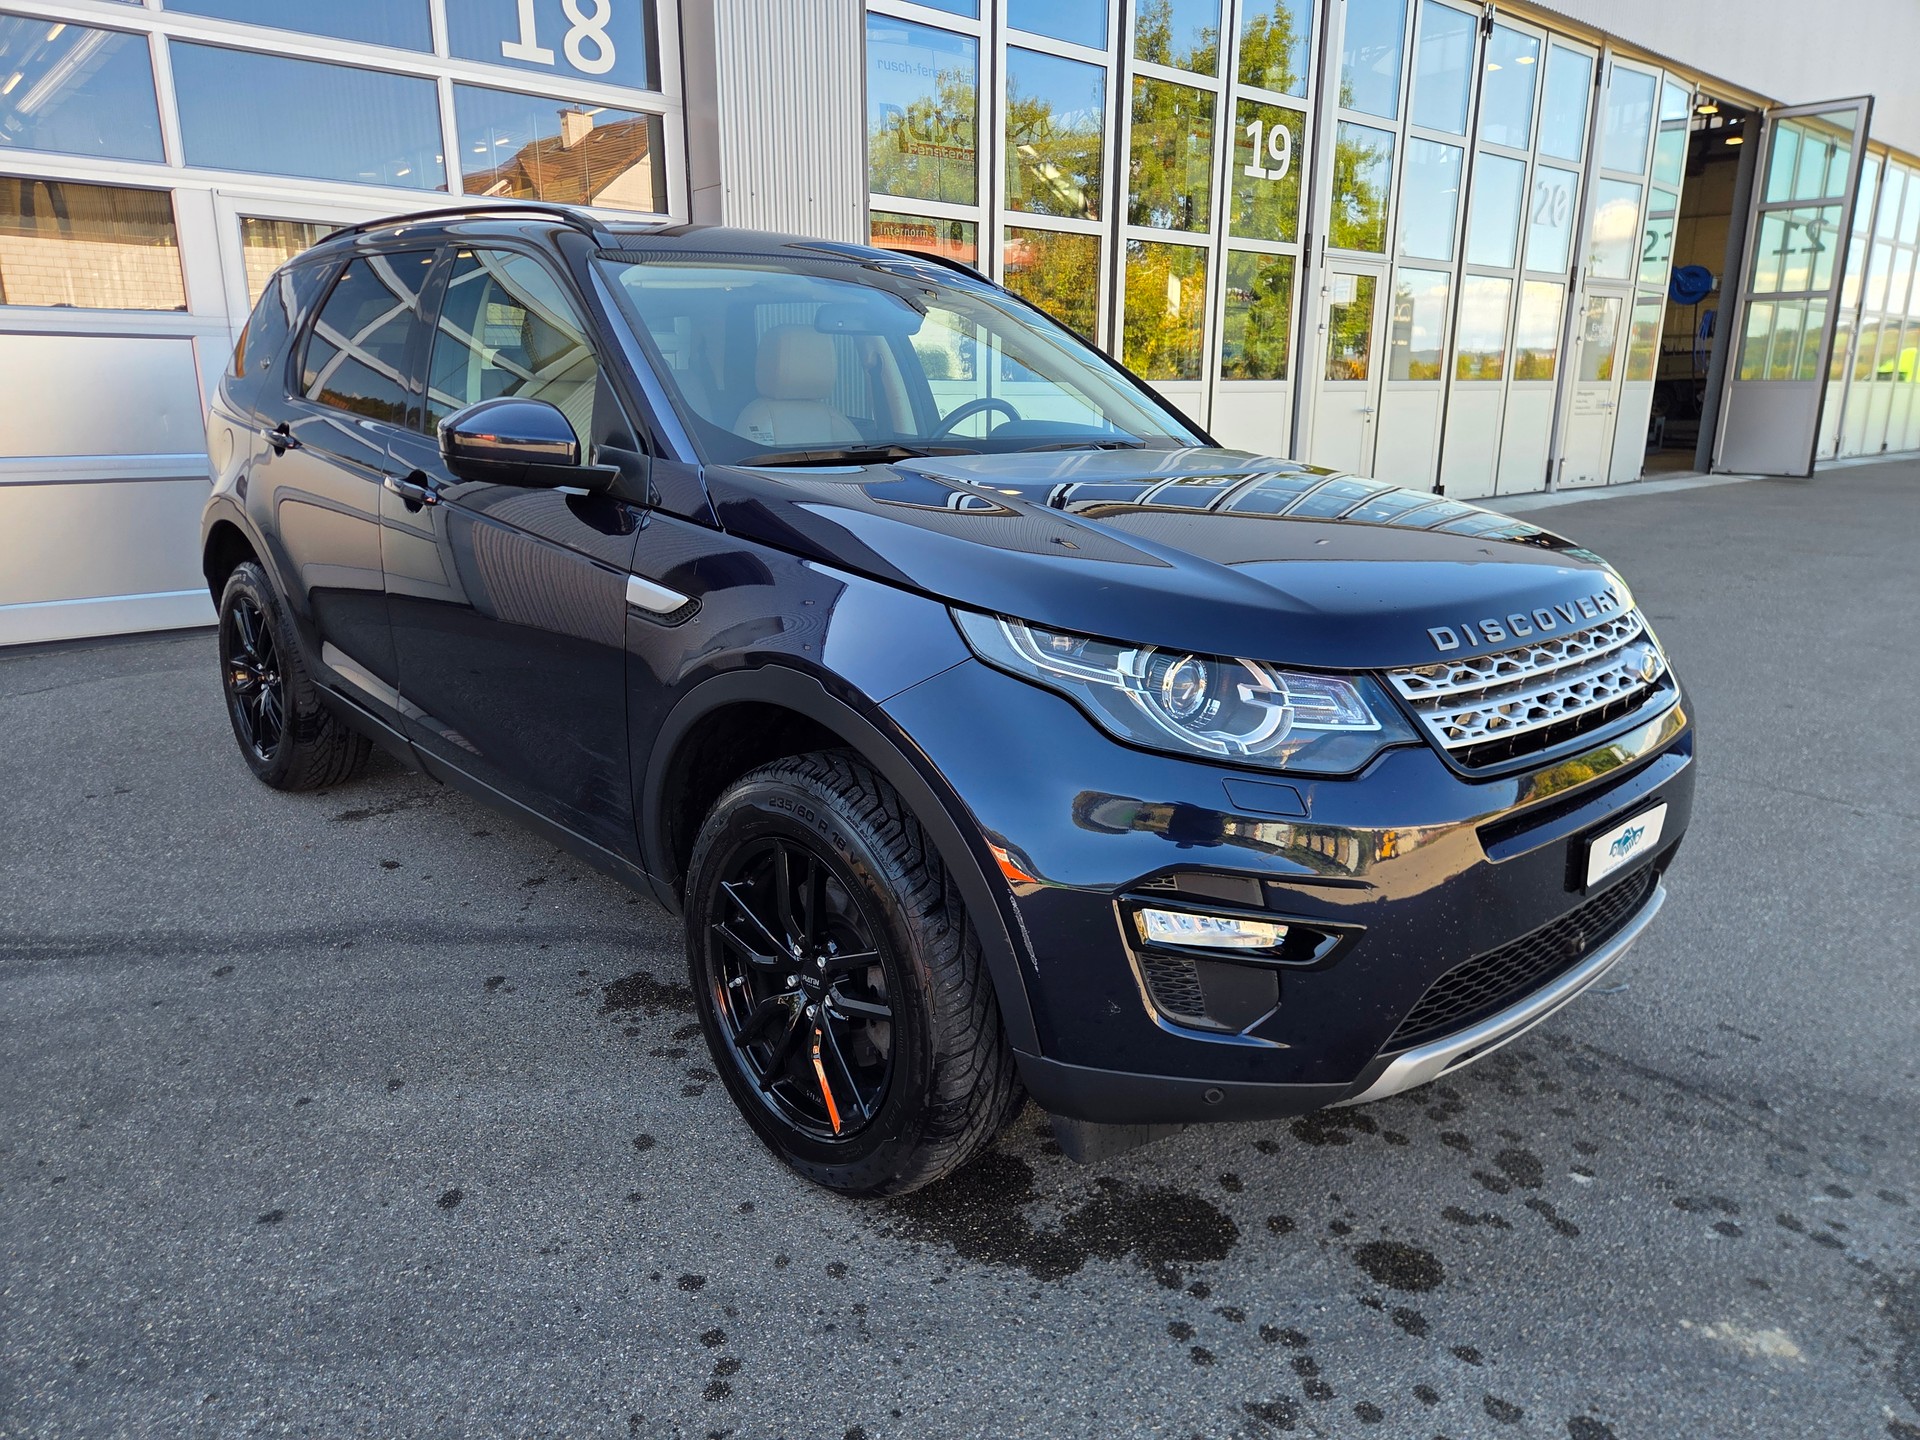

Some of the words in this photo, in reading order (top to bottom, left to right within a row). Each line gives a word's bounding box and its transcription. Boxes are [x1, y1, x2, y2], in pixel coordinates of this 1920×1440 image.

[501, 0, 616, 75] 18
[1244, 120, 1292, 181] 19
[880, 224, 928, 239] Internorm
[1427, 587, 1623, 651] DISCOVERY
[768, 797, 815, 824] 235/60
